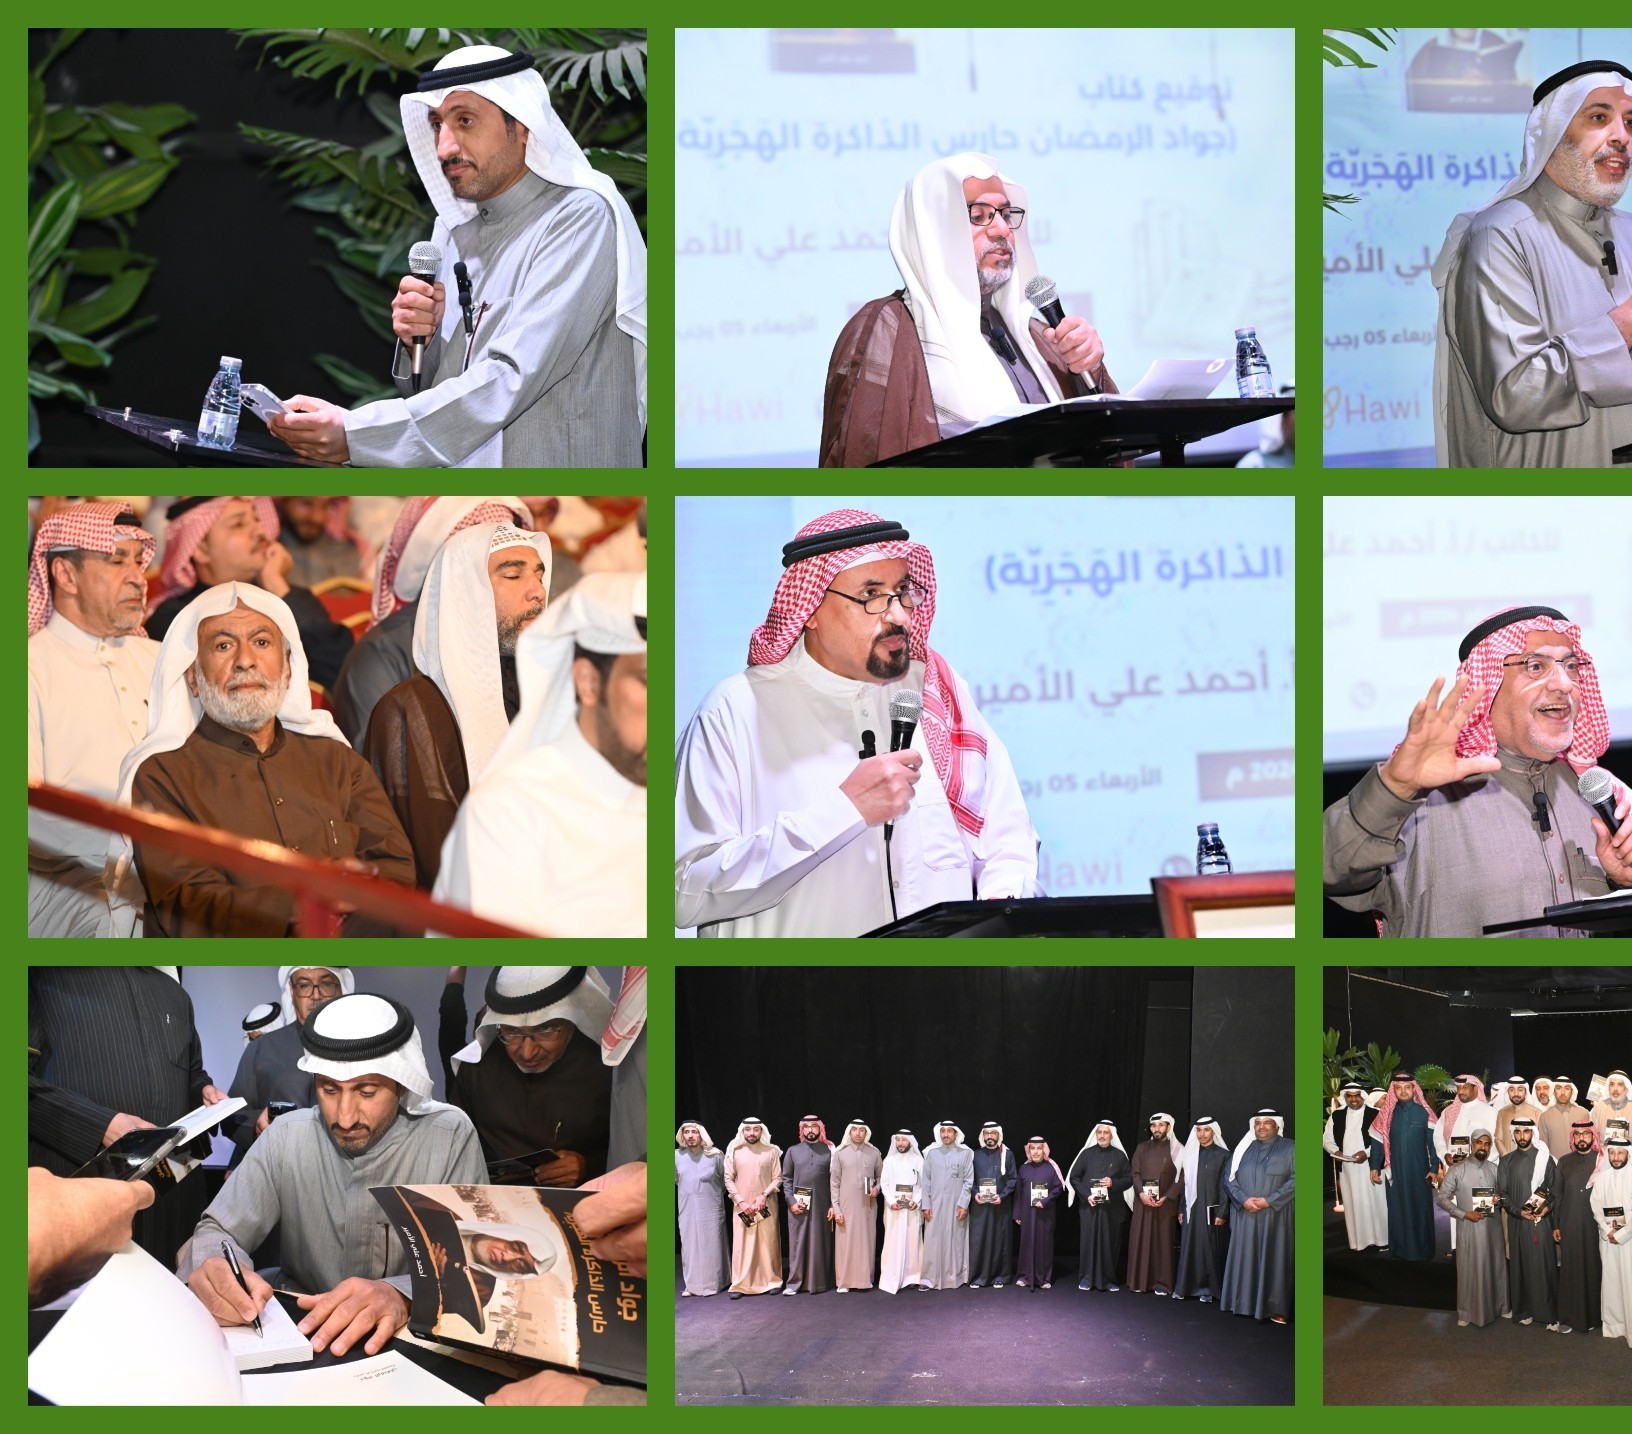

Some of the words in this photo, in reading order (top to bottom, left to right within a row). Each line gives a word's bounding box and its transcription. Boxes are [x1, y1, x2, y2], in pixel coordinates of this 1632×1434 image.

[1077, 74, 1144, 109] كتاب
[1153, 75, 1233, 114] توقيع
[812, 118, 920, 157] الذاكرة
[931, 121, 1019, 156] حارس
[1029, 121, 1154, 157] الرمضان
[755, 225, 818, 269] علي
[1325, 333, 1360, 351] رجب
[1363, 329, 1387, 345] 05
[1344, 392, 1421, 424] Hawi
[1155, 543, 1283, 591] الذاكرة
[975, 664, 1075, 714] الأمير
[1175, 646, 1269, 696] أحمد
[1090, 665, 1163, 717] علي
[1047, 771, 1078, 793] 05
[1084, 763, 1162, 794] الأربعاء
[401, 1225, 416, 1243] الأمير
[410, 1243, 421, 1258] علي
[587, 1294, 608, 1334] حارس
[617, 1281, 642, 1322] جواد
